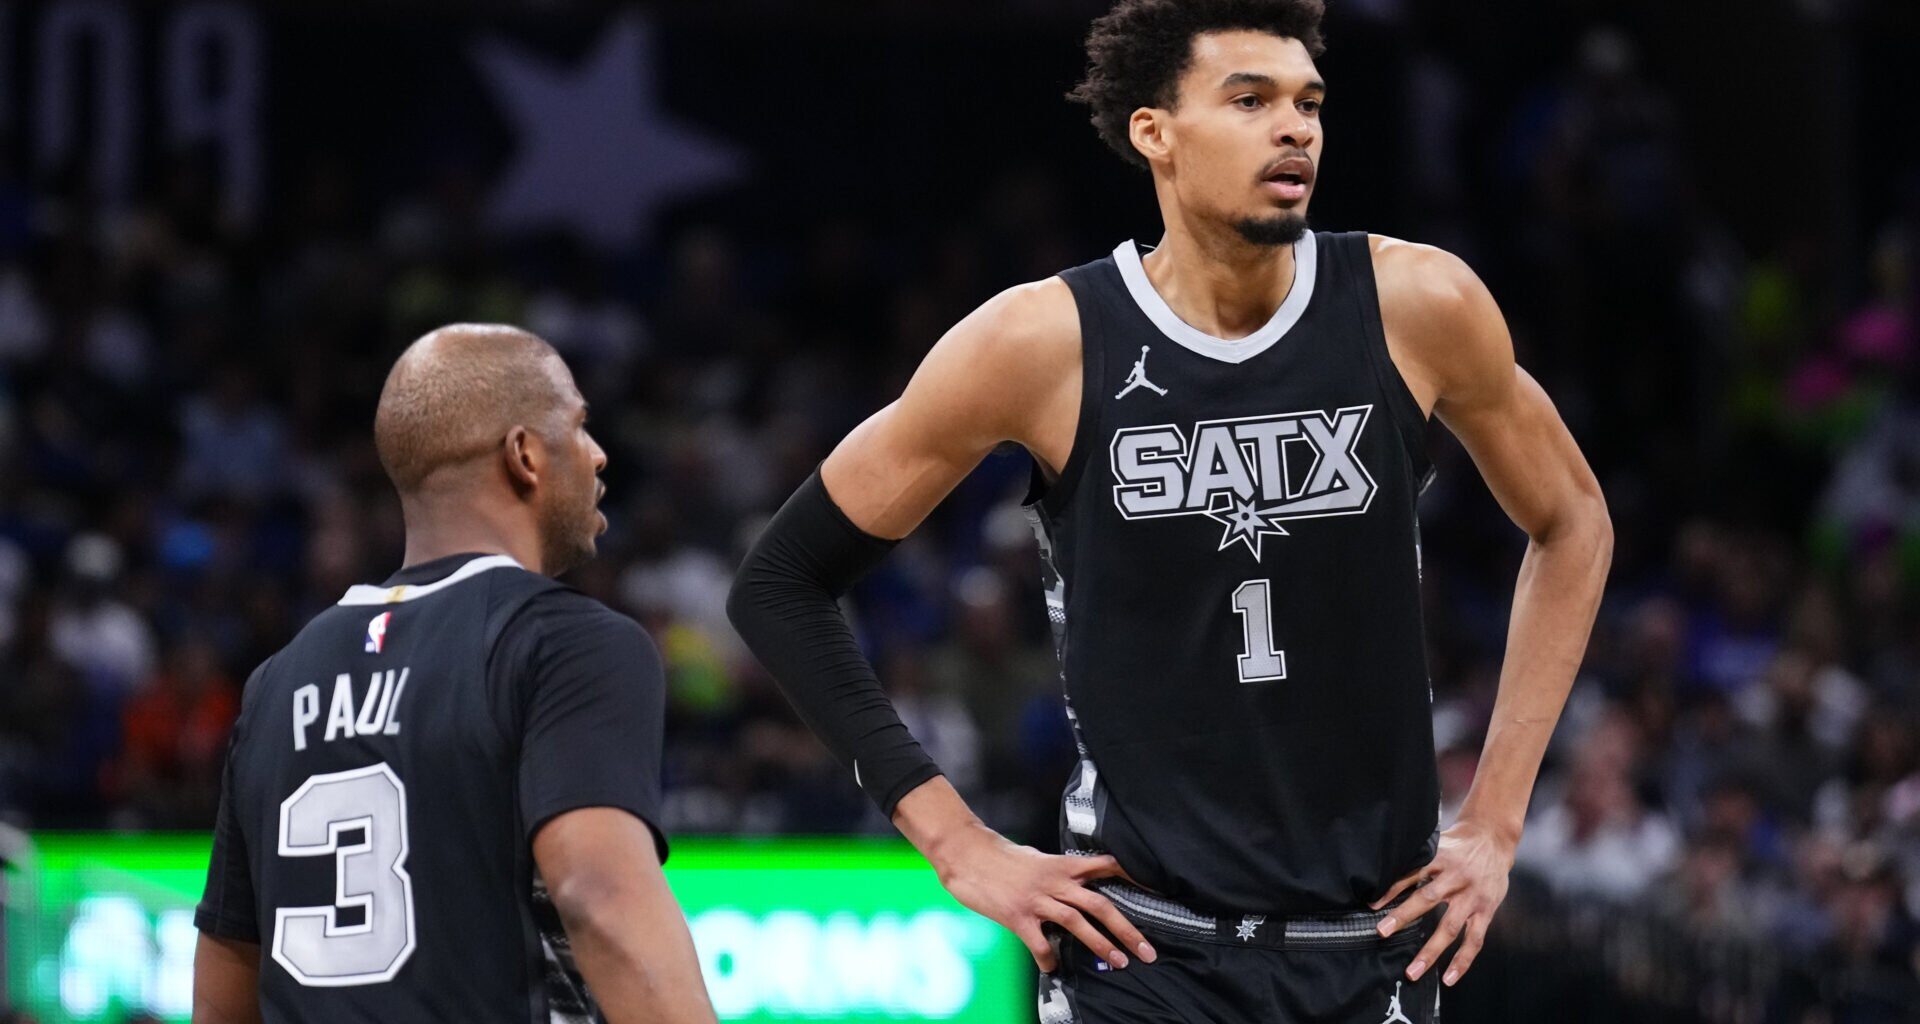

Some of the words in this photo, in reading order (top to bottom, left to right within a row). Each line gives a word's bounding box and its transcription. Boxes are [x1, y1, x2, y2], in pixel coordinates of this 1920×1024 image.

[1110, 404, 1378, 521] SATX
[1231, 579, 1287, 683] 1
[293, 667, 410, 751] PAUL
[271, 762, 416, 987] 3
